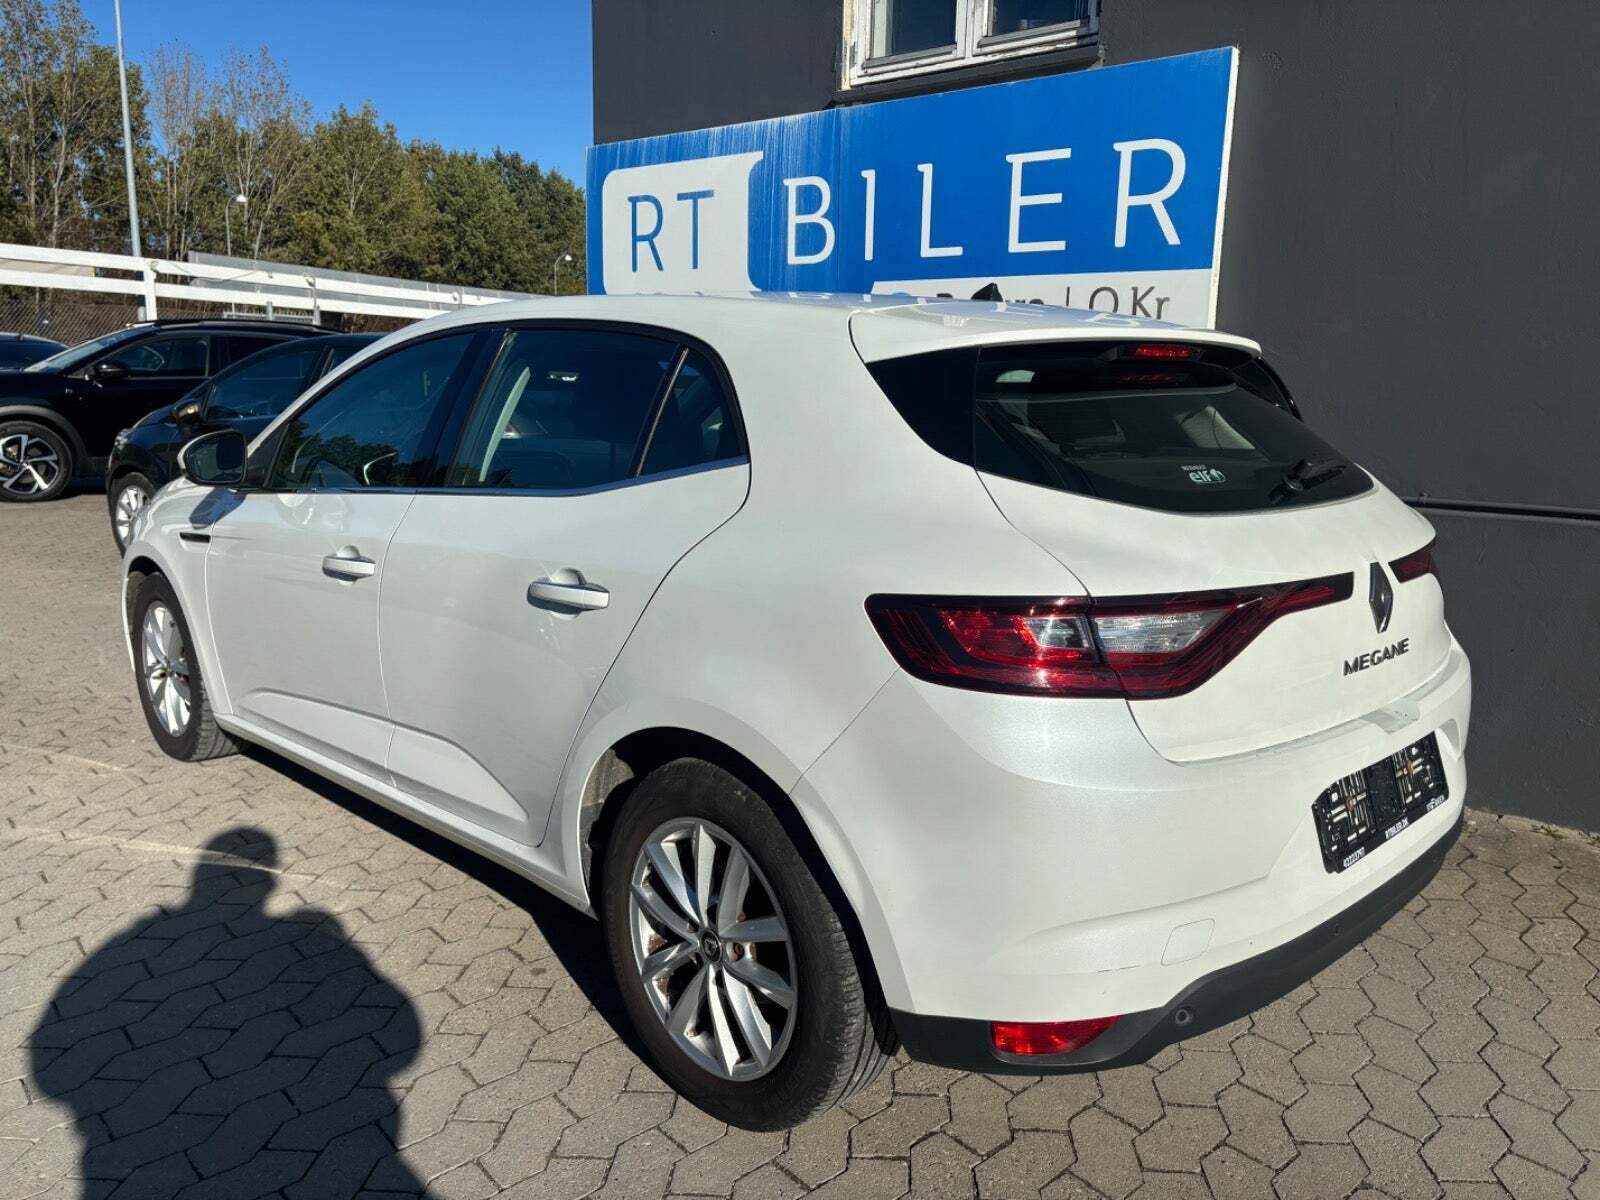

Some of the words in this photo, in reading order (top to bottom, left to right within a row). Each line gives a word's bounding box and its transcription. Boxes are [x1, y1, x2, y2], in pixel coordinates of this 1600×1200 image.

[626, 190, 715, 272] RT
[783, 138, 1186, 265] BILER
[1131, 286, 1171, 319] Kr
[1343, 637, 1409, 676] MEGANE
